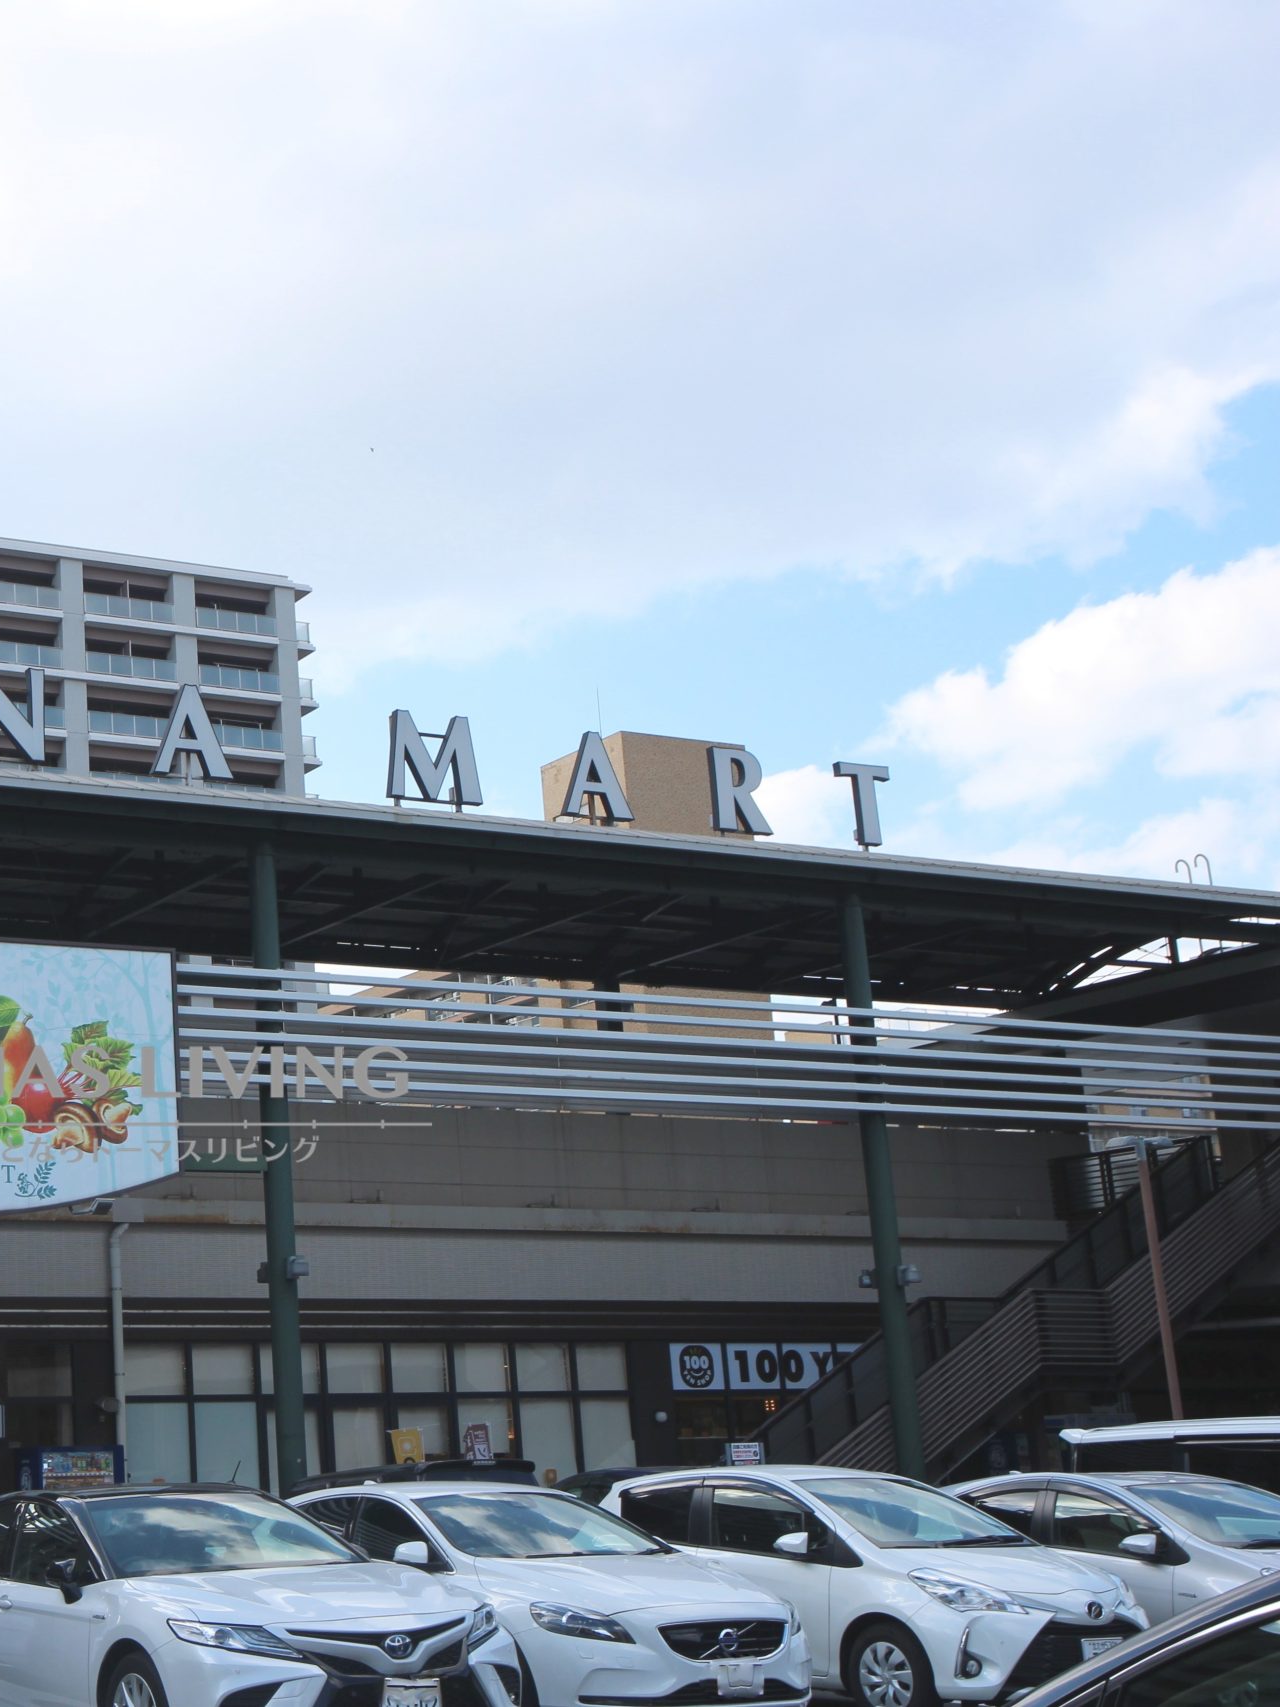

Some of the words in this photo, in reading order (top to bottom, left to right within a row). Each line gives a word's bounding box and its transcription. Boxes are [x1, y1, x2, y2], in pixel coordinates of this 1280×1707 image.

[386, 709, 889, 847] MART
[683, 1355, 709, 1369] 100
[734, 1350, 804, 1383] 100
